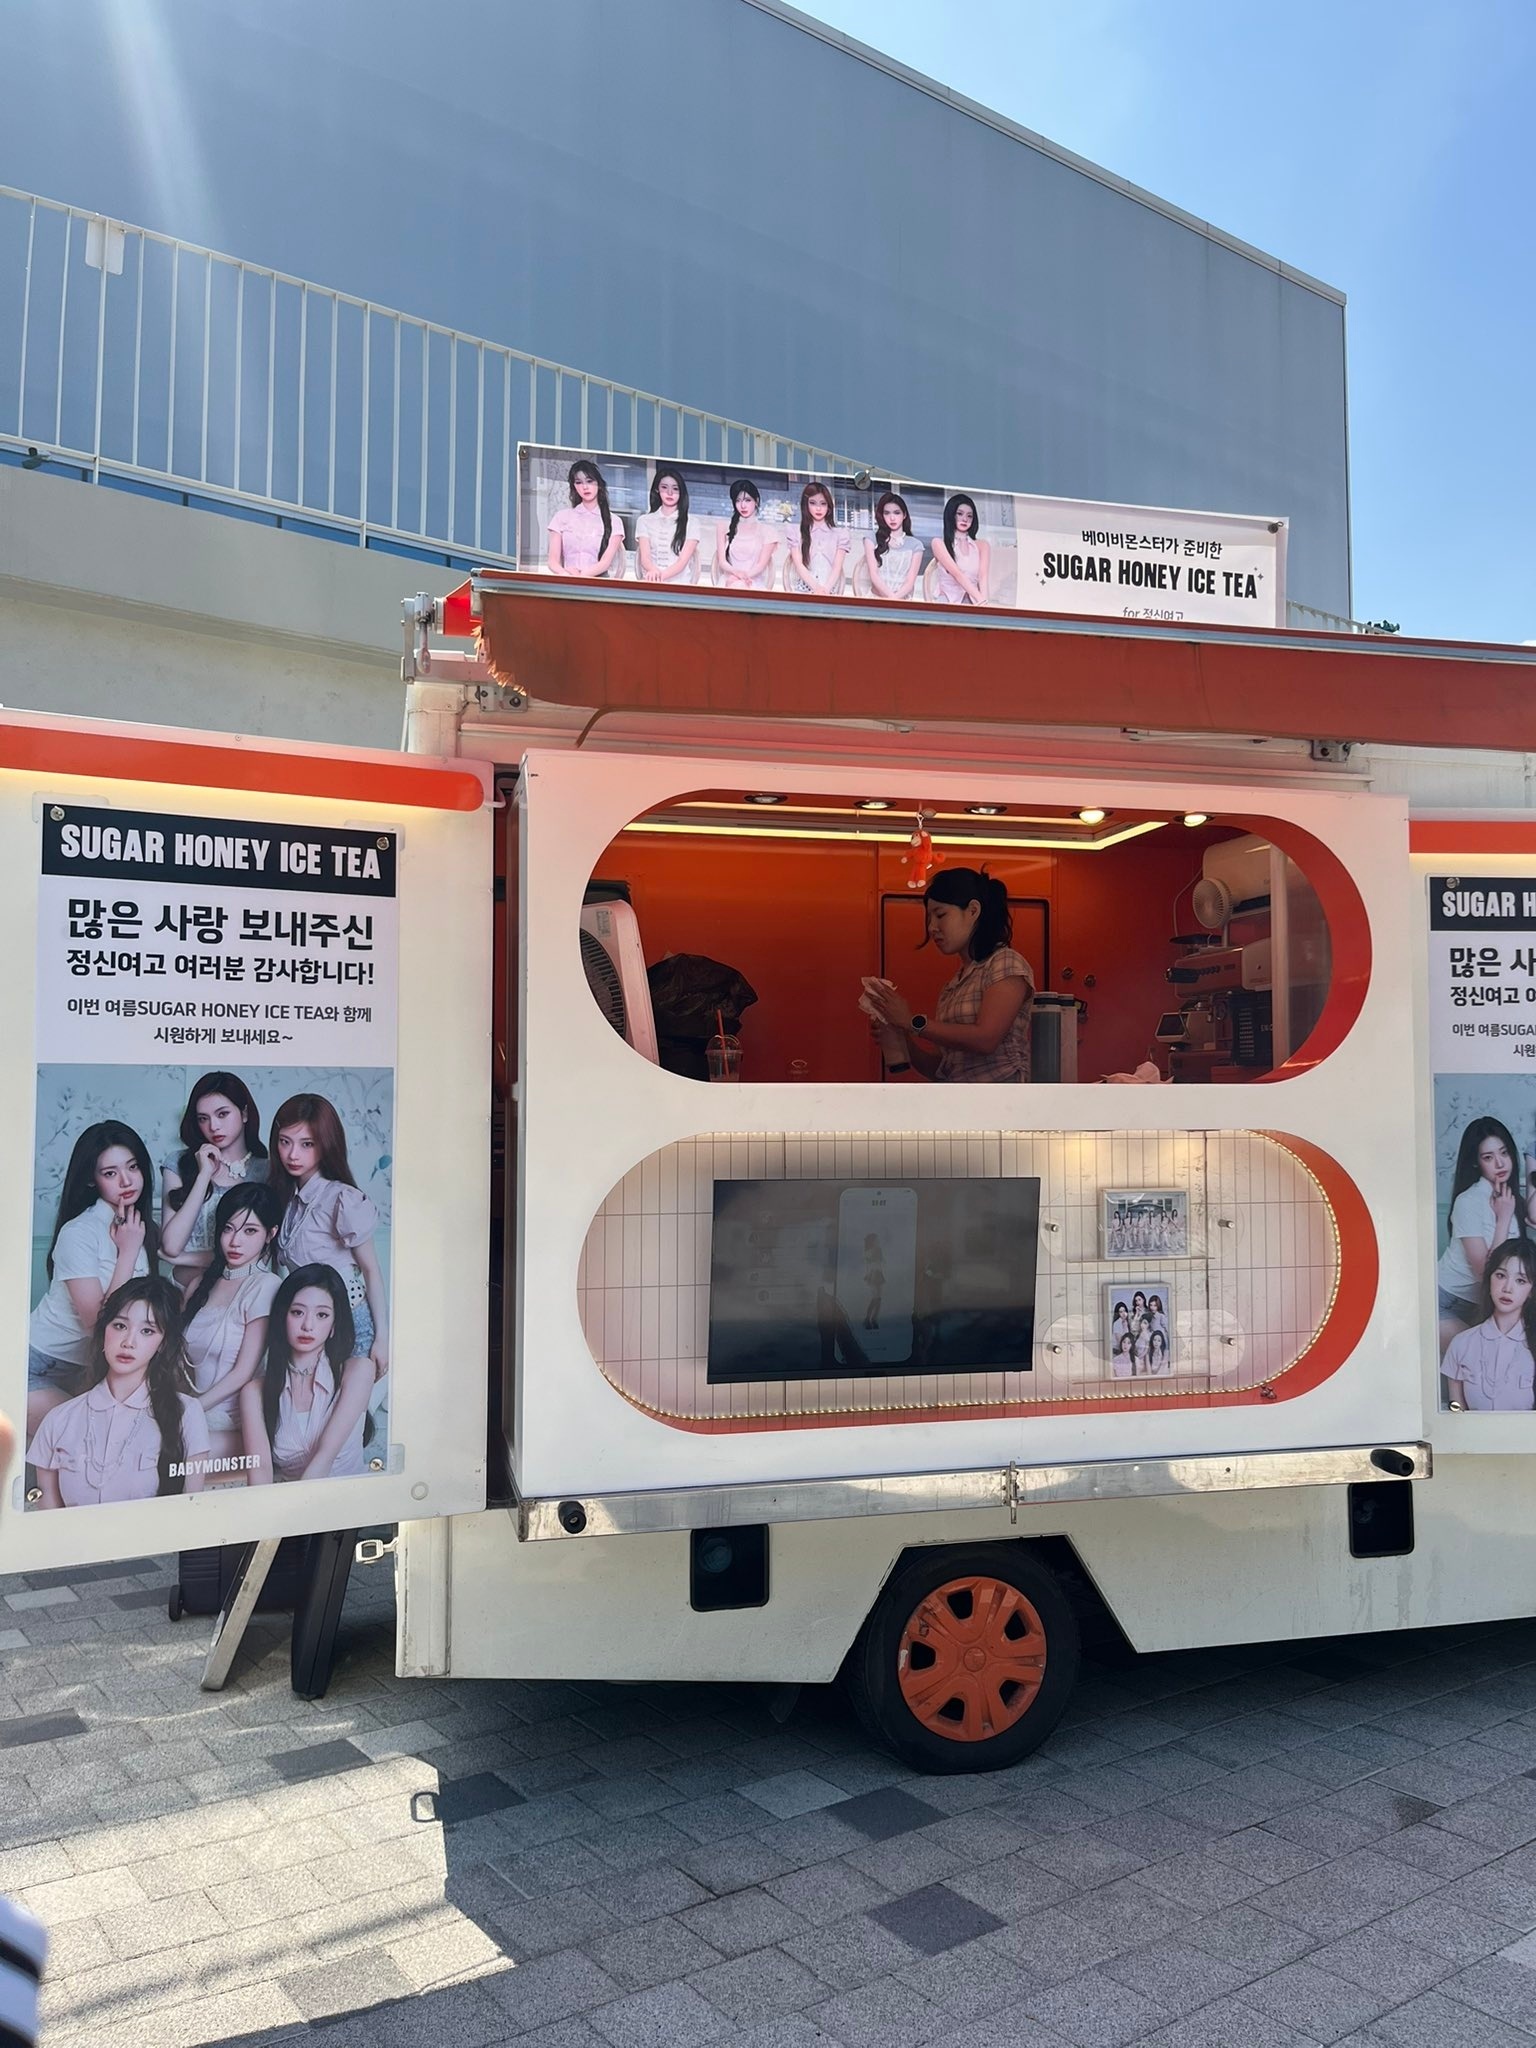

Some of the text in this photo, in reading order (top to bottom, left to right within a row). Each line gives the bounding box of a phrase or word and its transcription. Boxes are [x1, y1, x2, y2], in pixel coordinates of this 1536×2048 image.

[1082, 530, 1223, 560] 베이비몬스터가 준비한
[1043, 552, 1258, 599] SUGAR HONEY ICE TEA
[61, 824, 382, 880] SUGAR HONEY ICE TEA
[1442, 891, 1515, 917] SUGAR
[68, 898, 374, 951] 많은 사랑 보내주신
[66, 949, 374, 985] 정신여고 여러분 감사합니다!
[1450, 948, 1501, 978] 많은
[67, 998, 100, 1016] 이번
[202, 1003, 260, 1019] HONEY
[265, 1004, 290, 1020] ICE
[294, 1005, 340, 1022] TEA와
[343, 1006, 372, 1023] 함께
[1450, 986, 1520, 1007] 정신여고
[154, 1027, 293, 1045] 시원하게 보내세요~
[1452, 1024, 1475, 1037] 이번
[169, 1454, 261, 1477] BABYMONSTER
